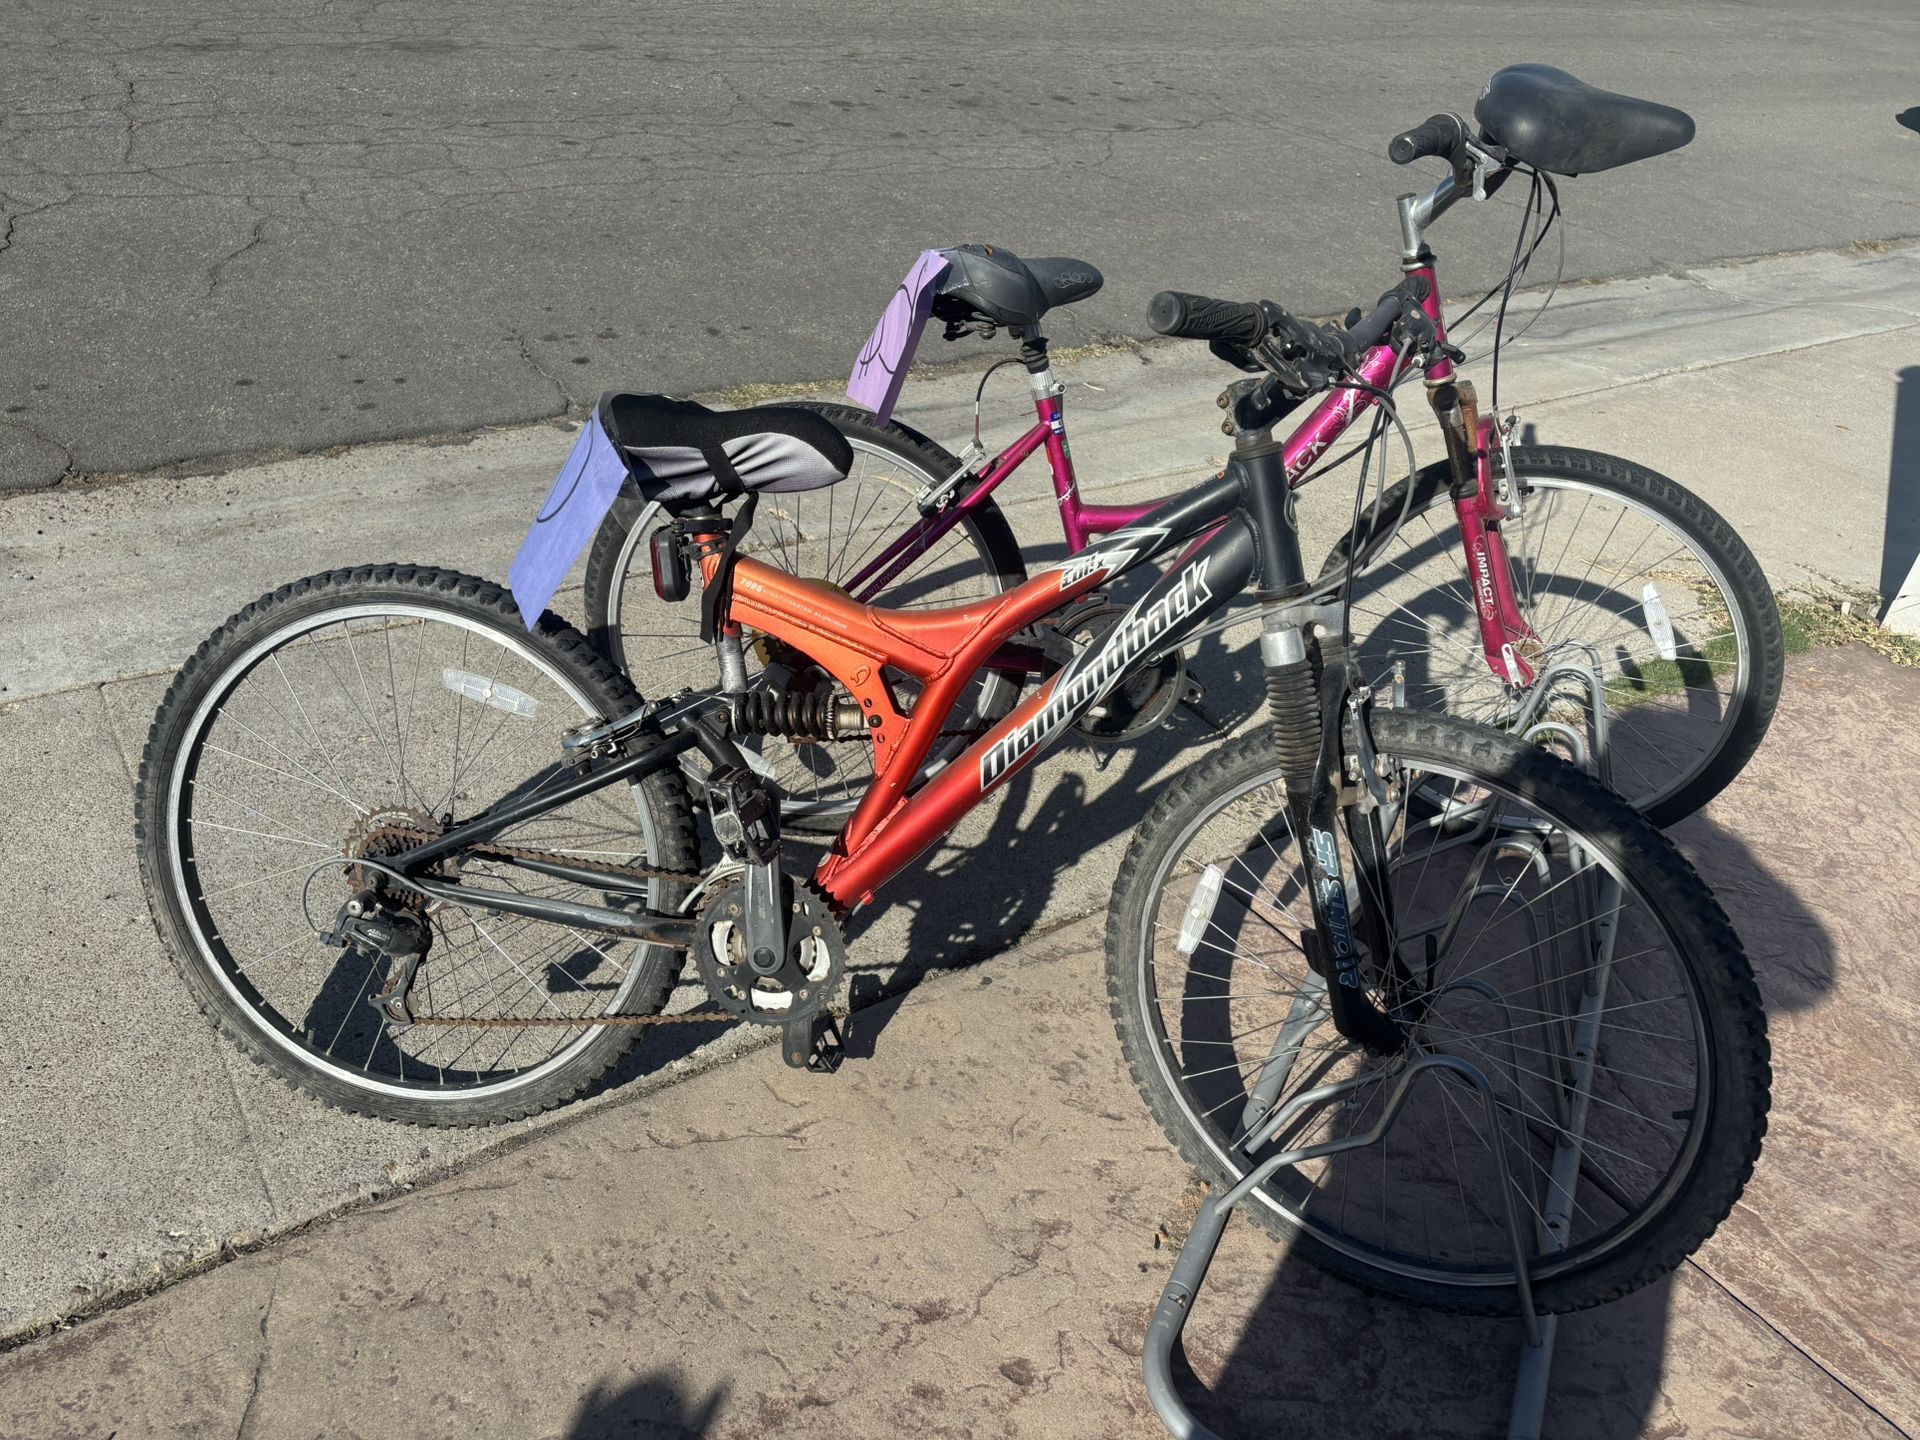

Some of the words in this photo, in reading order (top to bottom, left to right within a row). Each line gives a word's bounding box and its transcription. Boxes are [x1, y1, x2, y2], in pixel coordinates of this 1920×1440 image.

[739, 577, 762, 593] 7005
[865, 556, 911, 598] WILDWOOD
[1476, 552, 1494, 605] IMPACT
[980, 555, 1214, 792] Diamondback
[1312, 828, 1339, 877] SR
